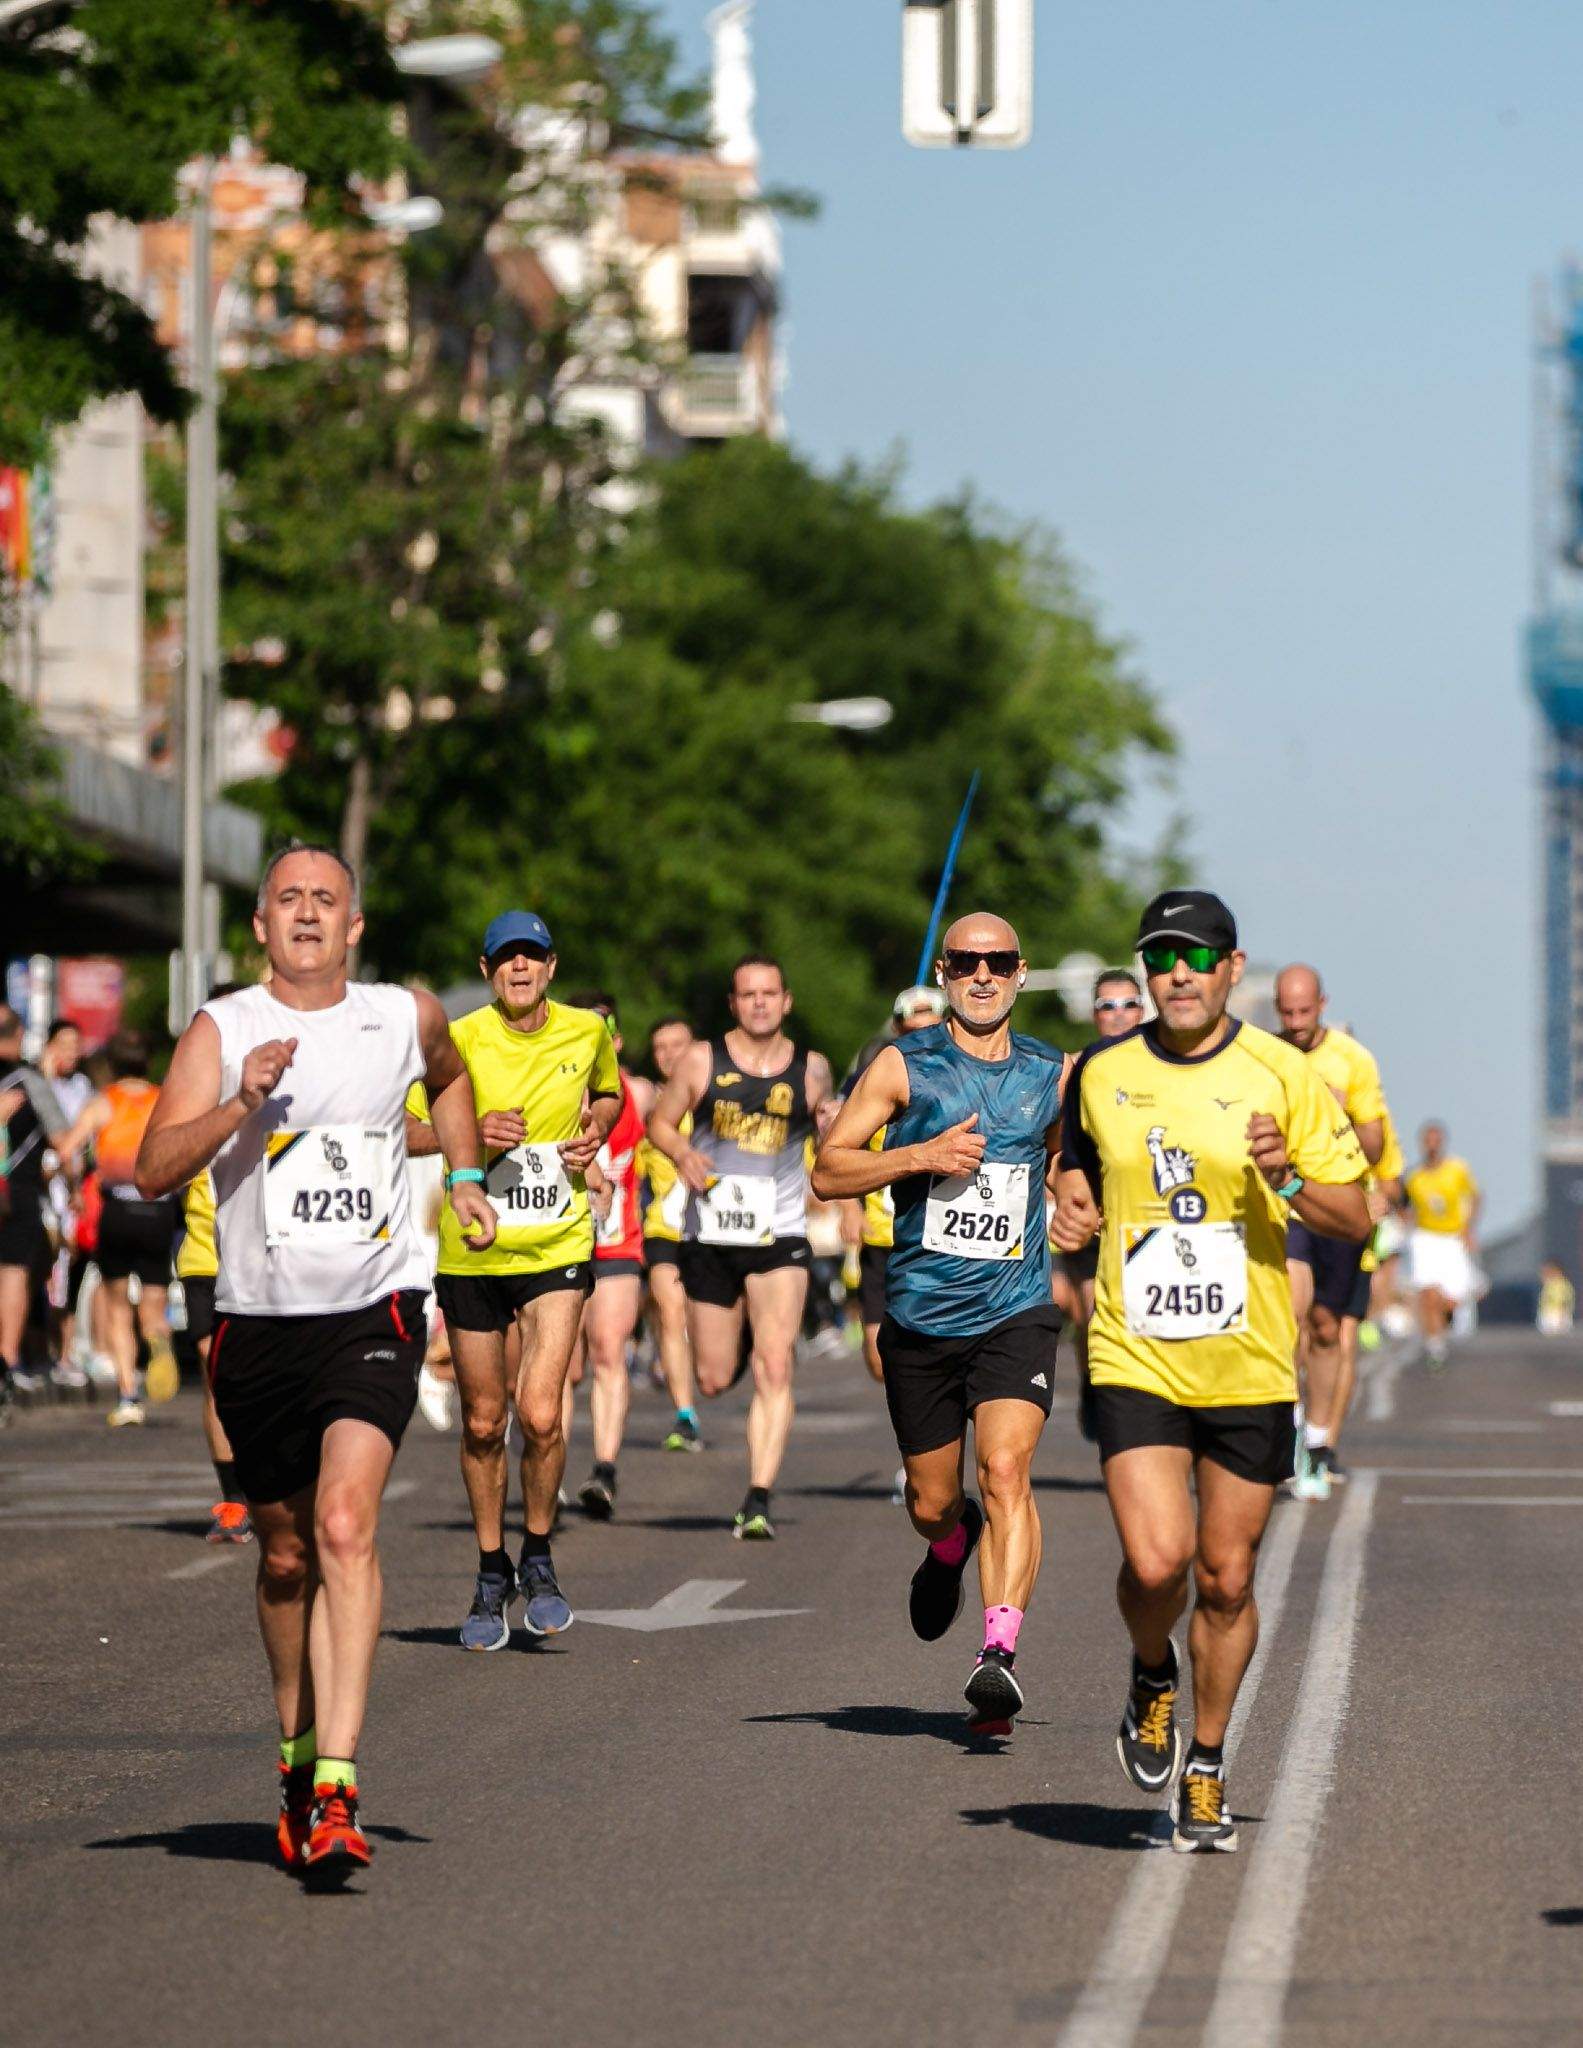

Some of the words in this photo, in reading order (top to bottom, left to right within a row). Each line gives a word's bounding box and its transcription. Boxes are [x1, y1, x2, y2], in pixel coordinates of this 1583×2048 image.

[291, 1187, 373, 1223] 4239
[505, 1185, 558, 1210] 1088
[1176, 1195, 1201, 1218] 13
[943, 1209, 1010, 1242] 2526
[1145, 1282, 1224, 1316] 2456
